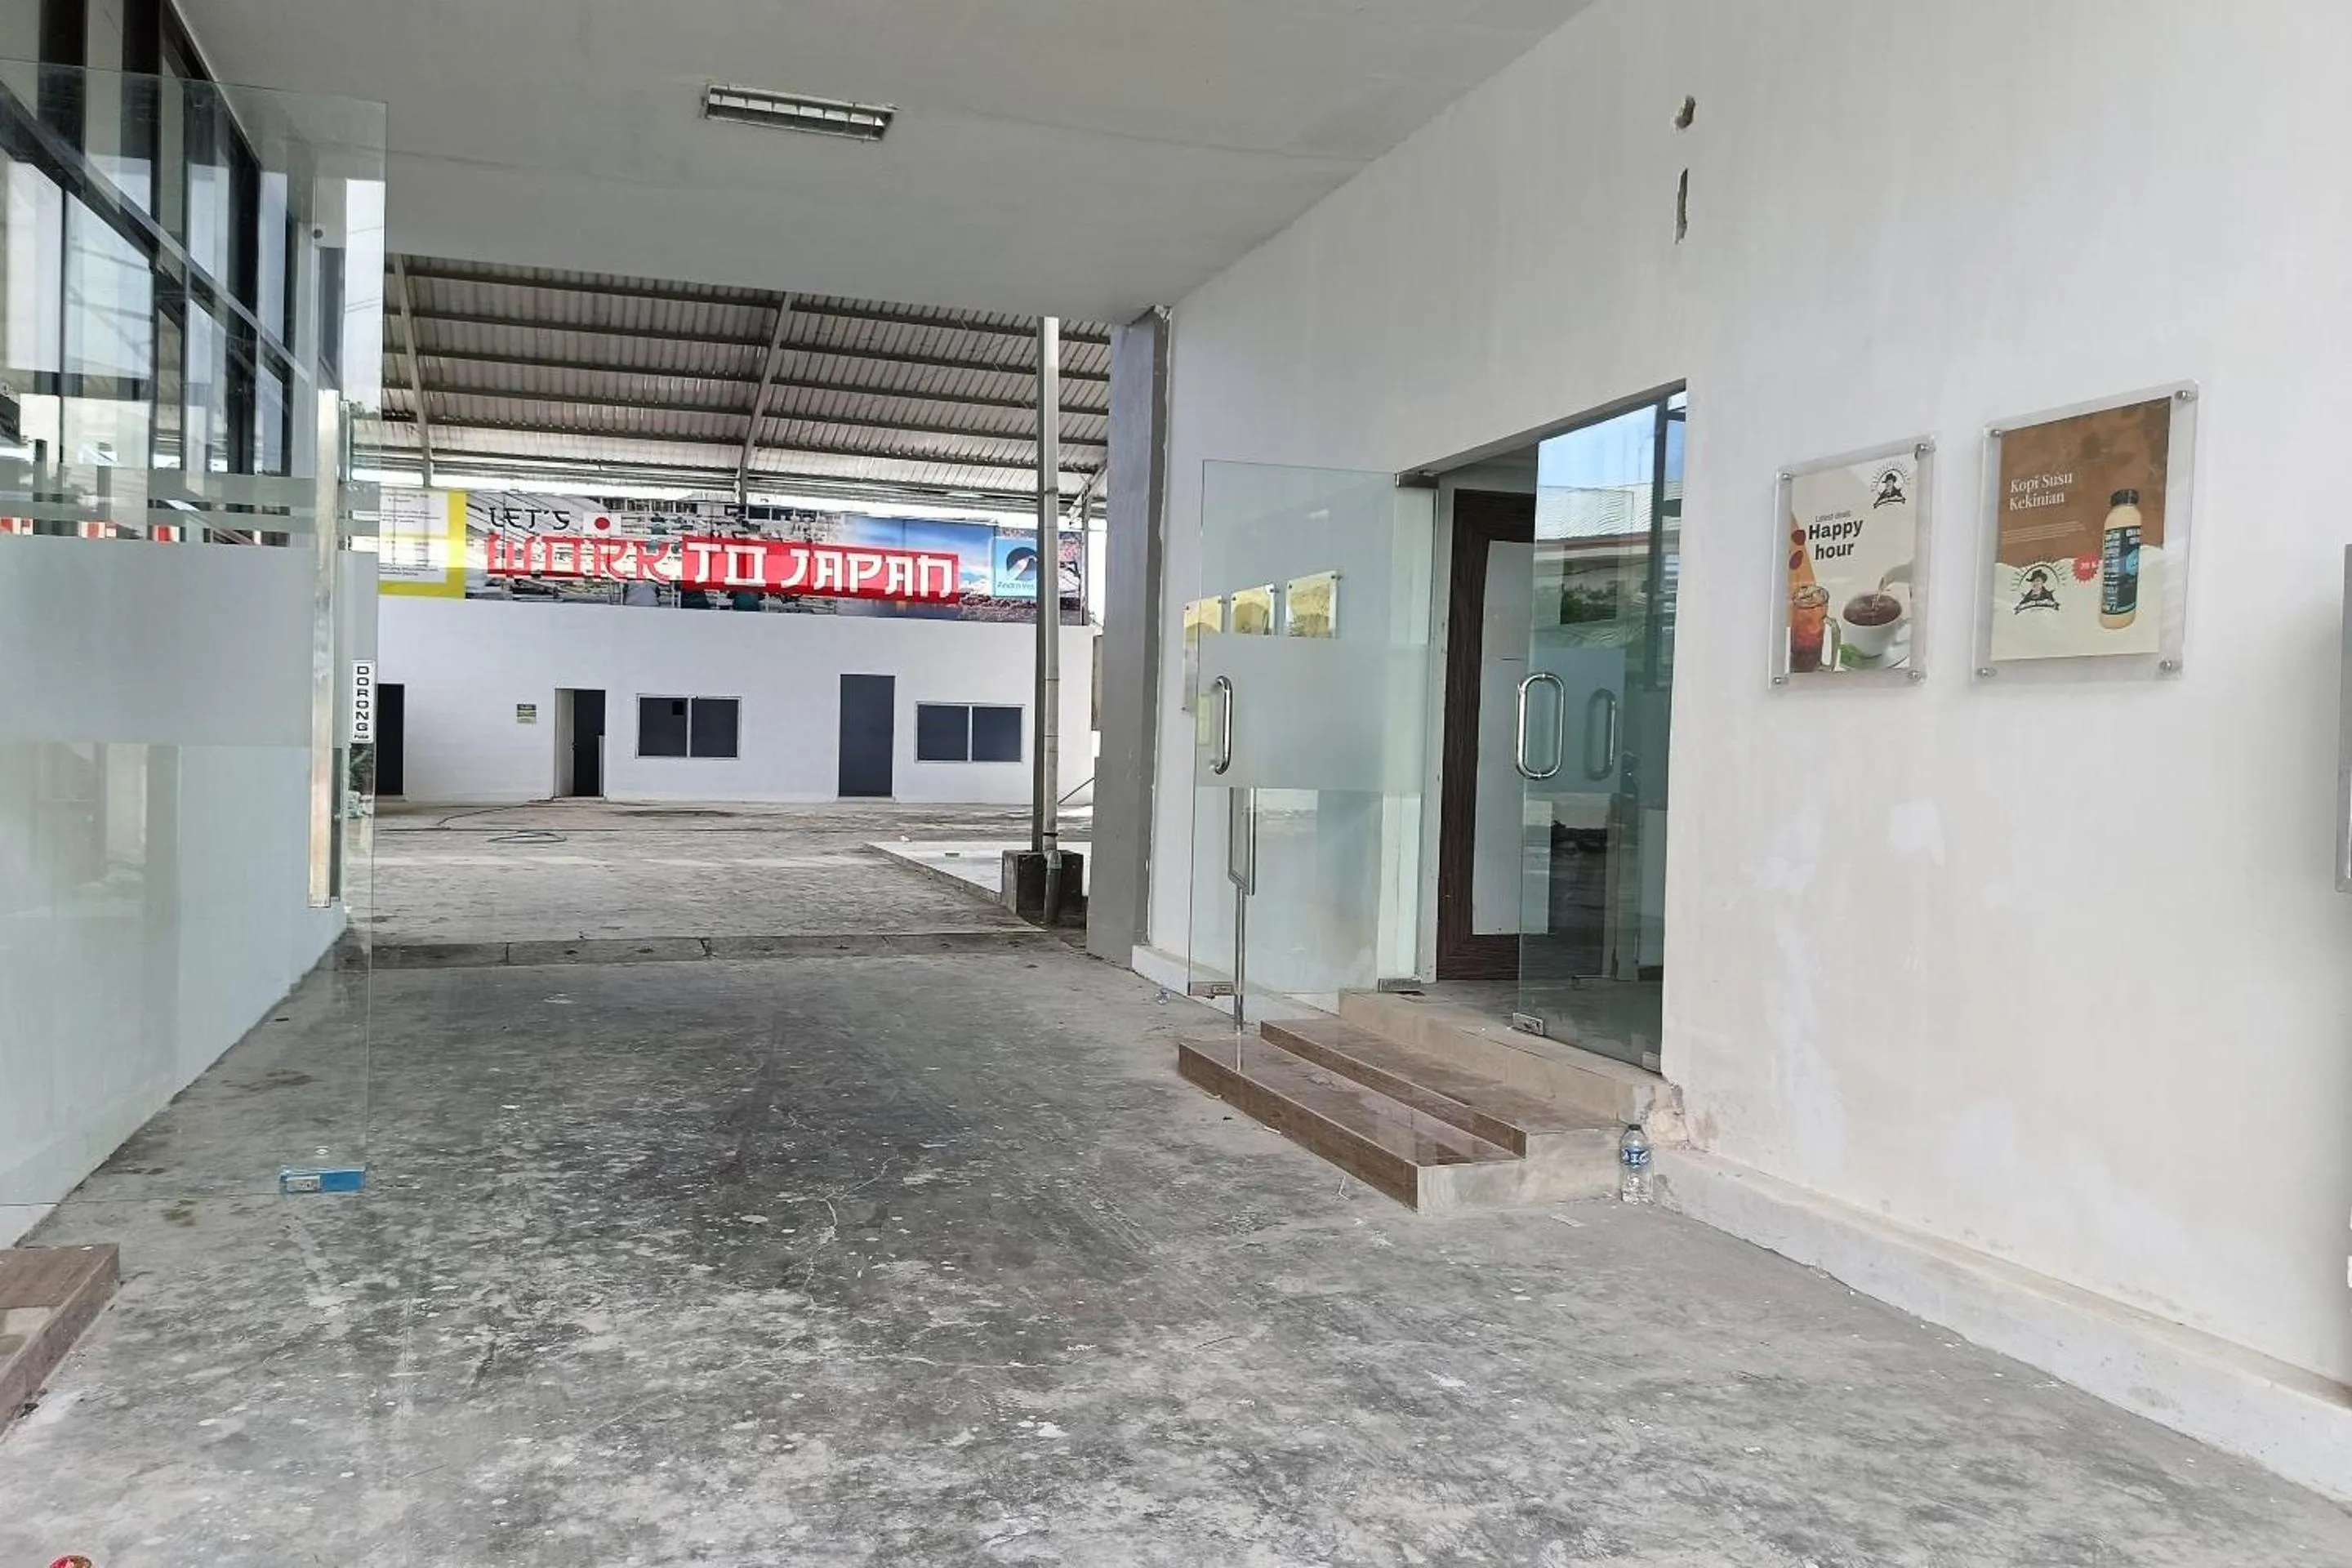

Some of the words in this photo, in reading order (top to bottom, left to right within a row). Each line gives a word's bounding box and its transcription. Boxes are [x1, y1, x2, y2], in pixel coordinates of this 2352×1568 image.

[2011, 474, 2039, 493] Kopi
[2042, 472, 2073, 488] Susu
[2009, 491, 2065, 511] Kekinian
[488, 506, 571, 530] LET'S
[1808, 520, 1864, 541] Happy
[1815, 543, 1854, 560] hour
[487, 532, 673, 584] WORK
[687, 541, 767, 587] TO
[780, 547, 953, 599] JAPAN
[355, 666, 370, 732] DORONG
